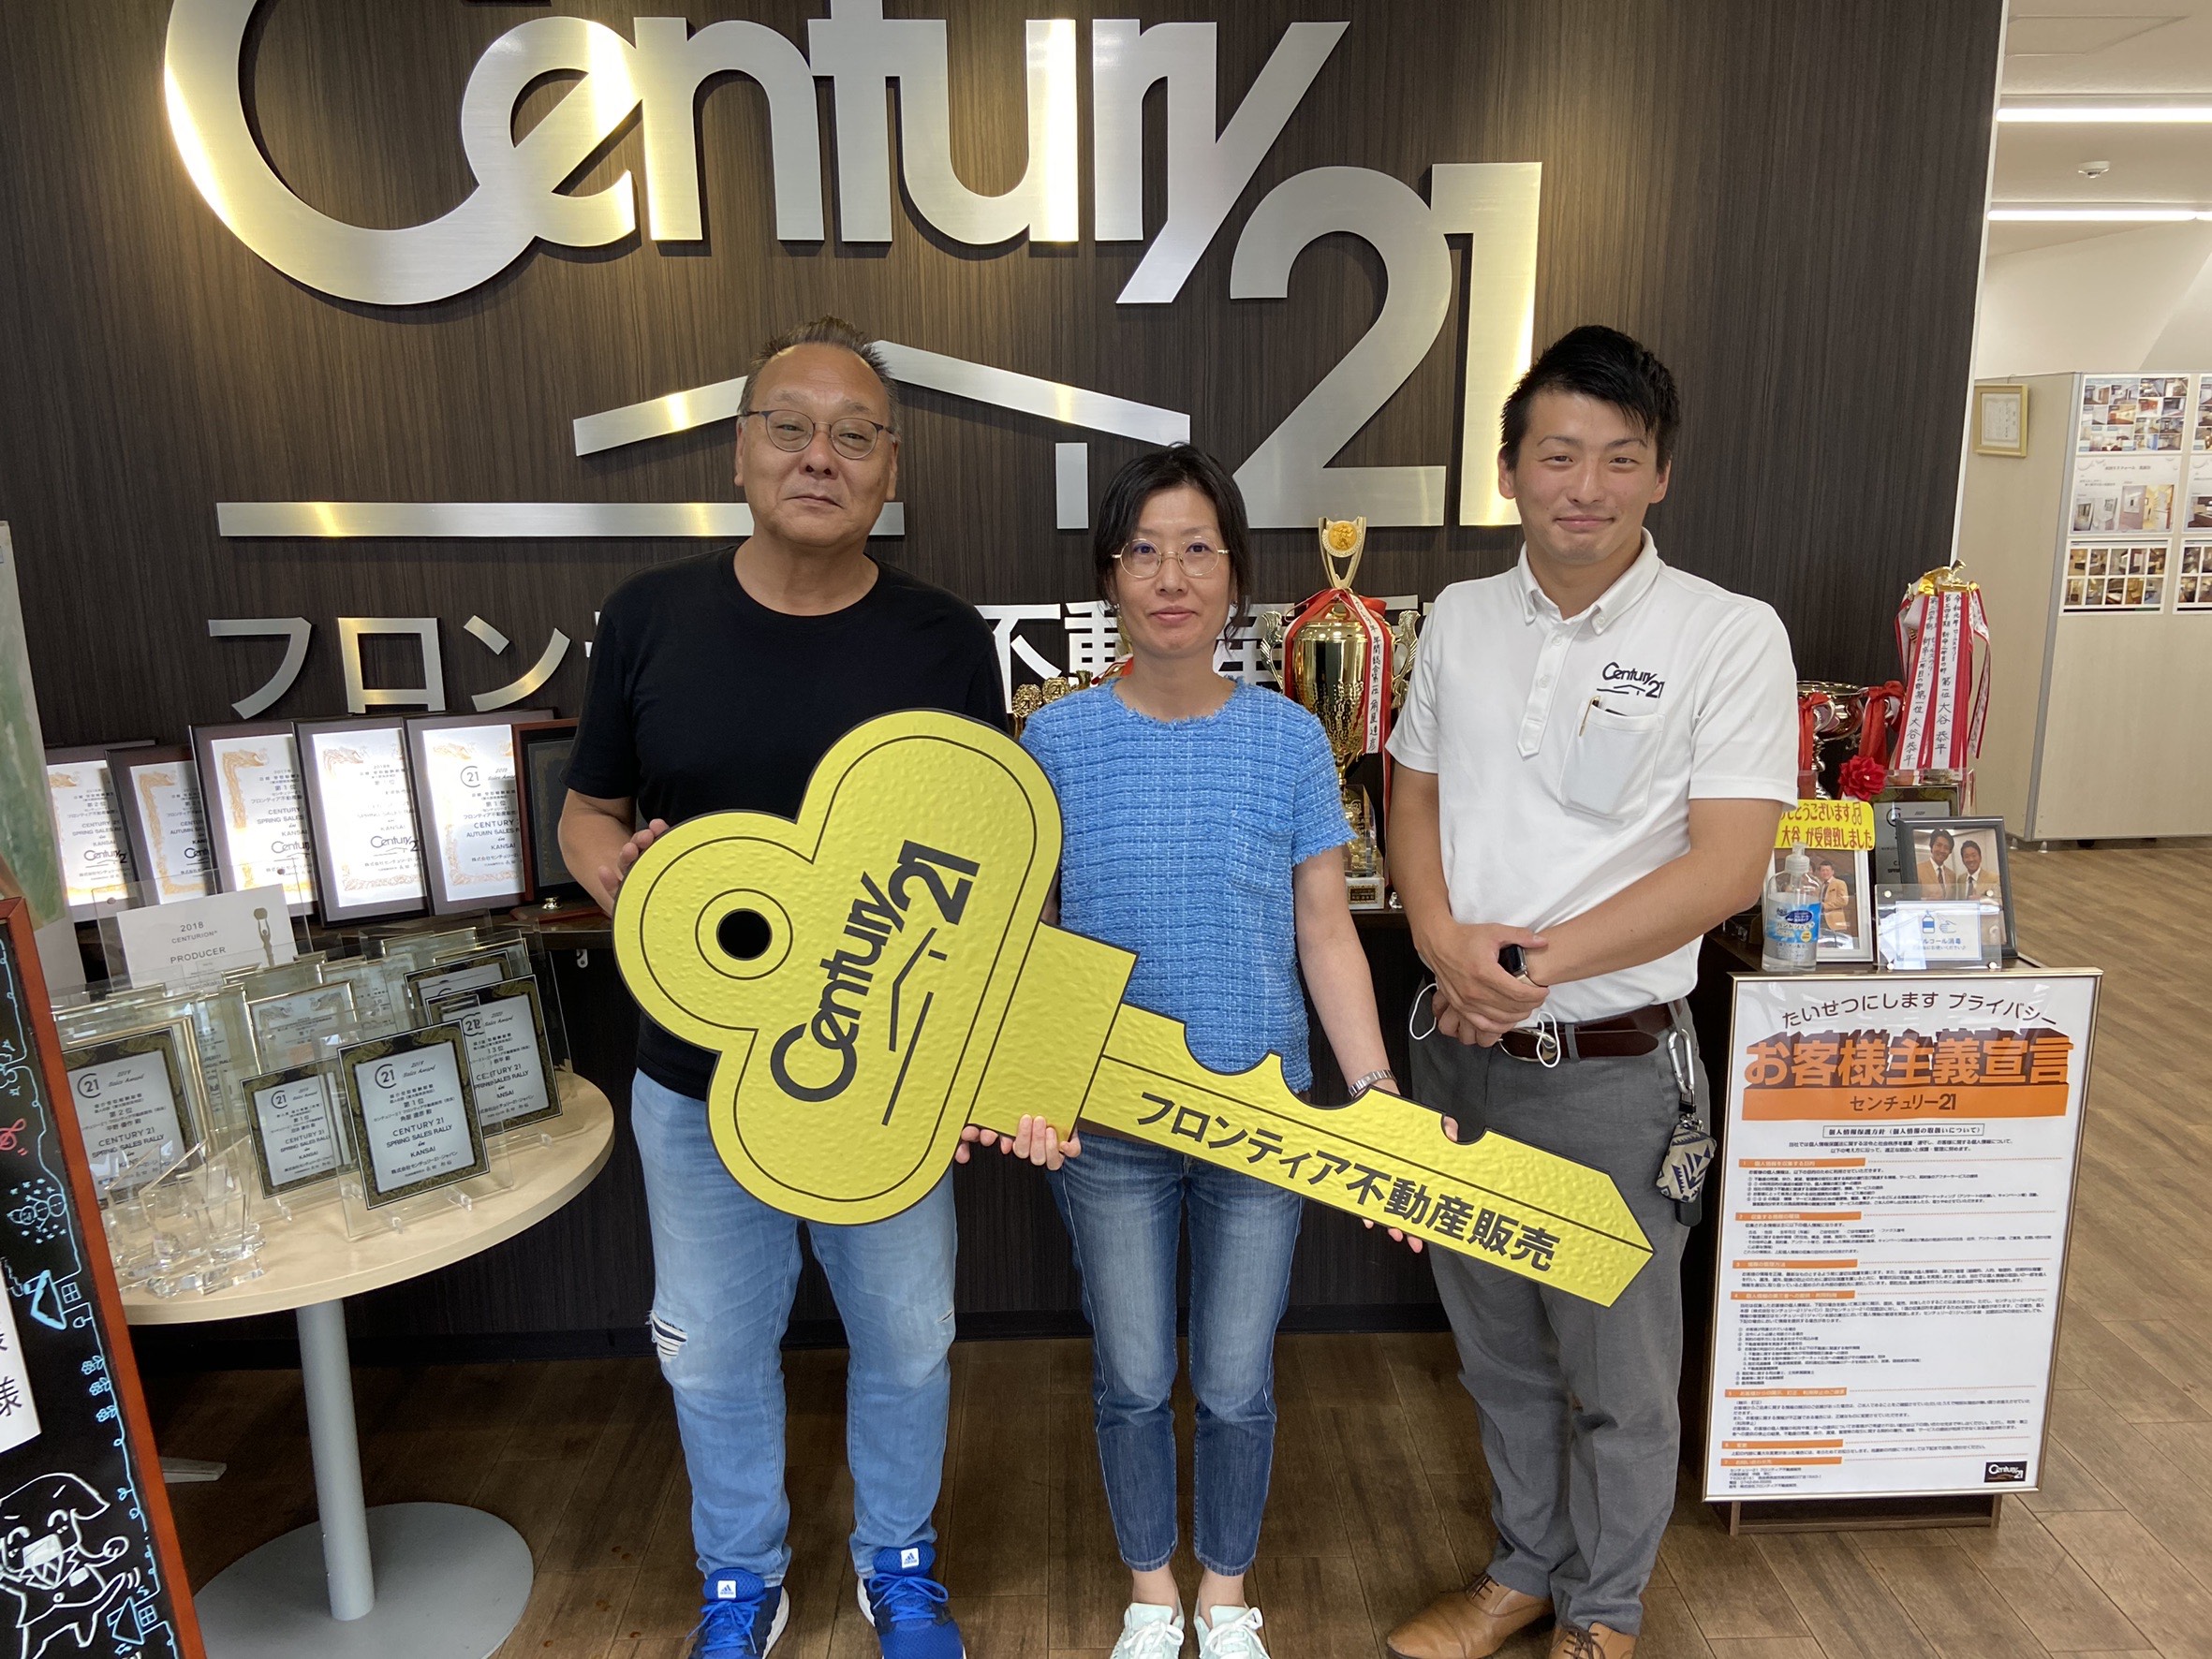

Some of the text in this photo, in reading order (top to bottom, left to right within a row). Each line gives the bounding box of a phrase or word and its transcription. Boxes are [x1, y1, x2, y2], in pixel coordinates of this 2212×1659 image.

[165, 0, 1349, 305] Century
[1229, 162, 1542, 528] 21
[1602, 662, 1658, 684] Century
[1645, 680, 1665, 698] 21
[473, 820, 514, 829] CENTURY
[370, 835, 412, 848] Century
[888, 840, 981, 925] 21
[180, 921, 204, 932] 2018
[170, 947, 226, 963] PRODUCER
[771, 872, 905, 1103] Century
[1782, 992, 2057, 1030] たいせつにします プライバシー
[1744, 1035, 2074, 1087] お客様主義宣言
[1850, 1093, 1956, 1113] センチュリー21
[98, 1130, 144, 1147] CENTURY
[285, 1130, 317, 1144] CENTURY
[386, 1124, 453, 1149] SPRING SALES RALLY
[392, 1120, 434, 1138] CENTURY
[120, 1140, 142, 1152] SALES
[143, 1134, 165, 1144] RALLY
[410, 1146, 436, 1158] KANSAI
[1137, 1092, 1561, 1272] フロンティア不動産販売
